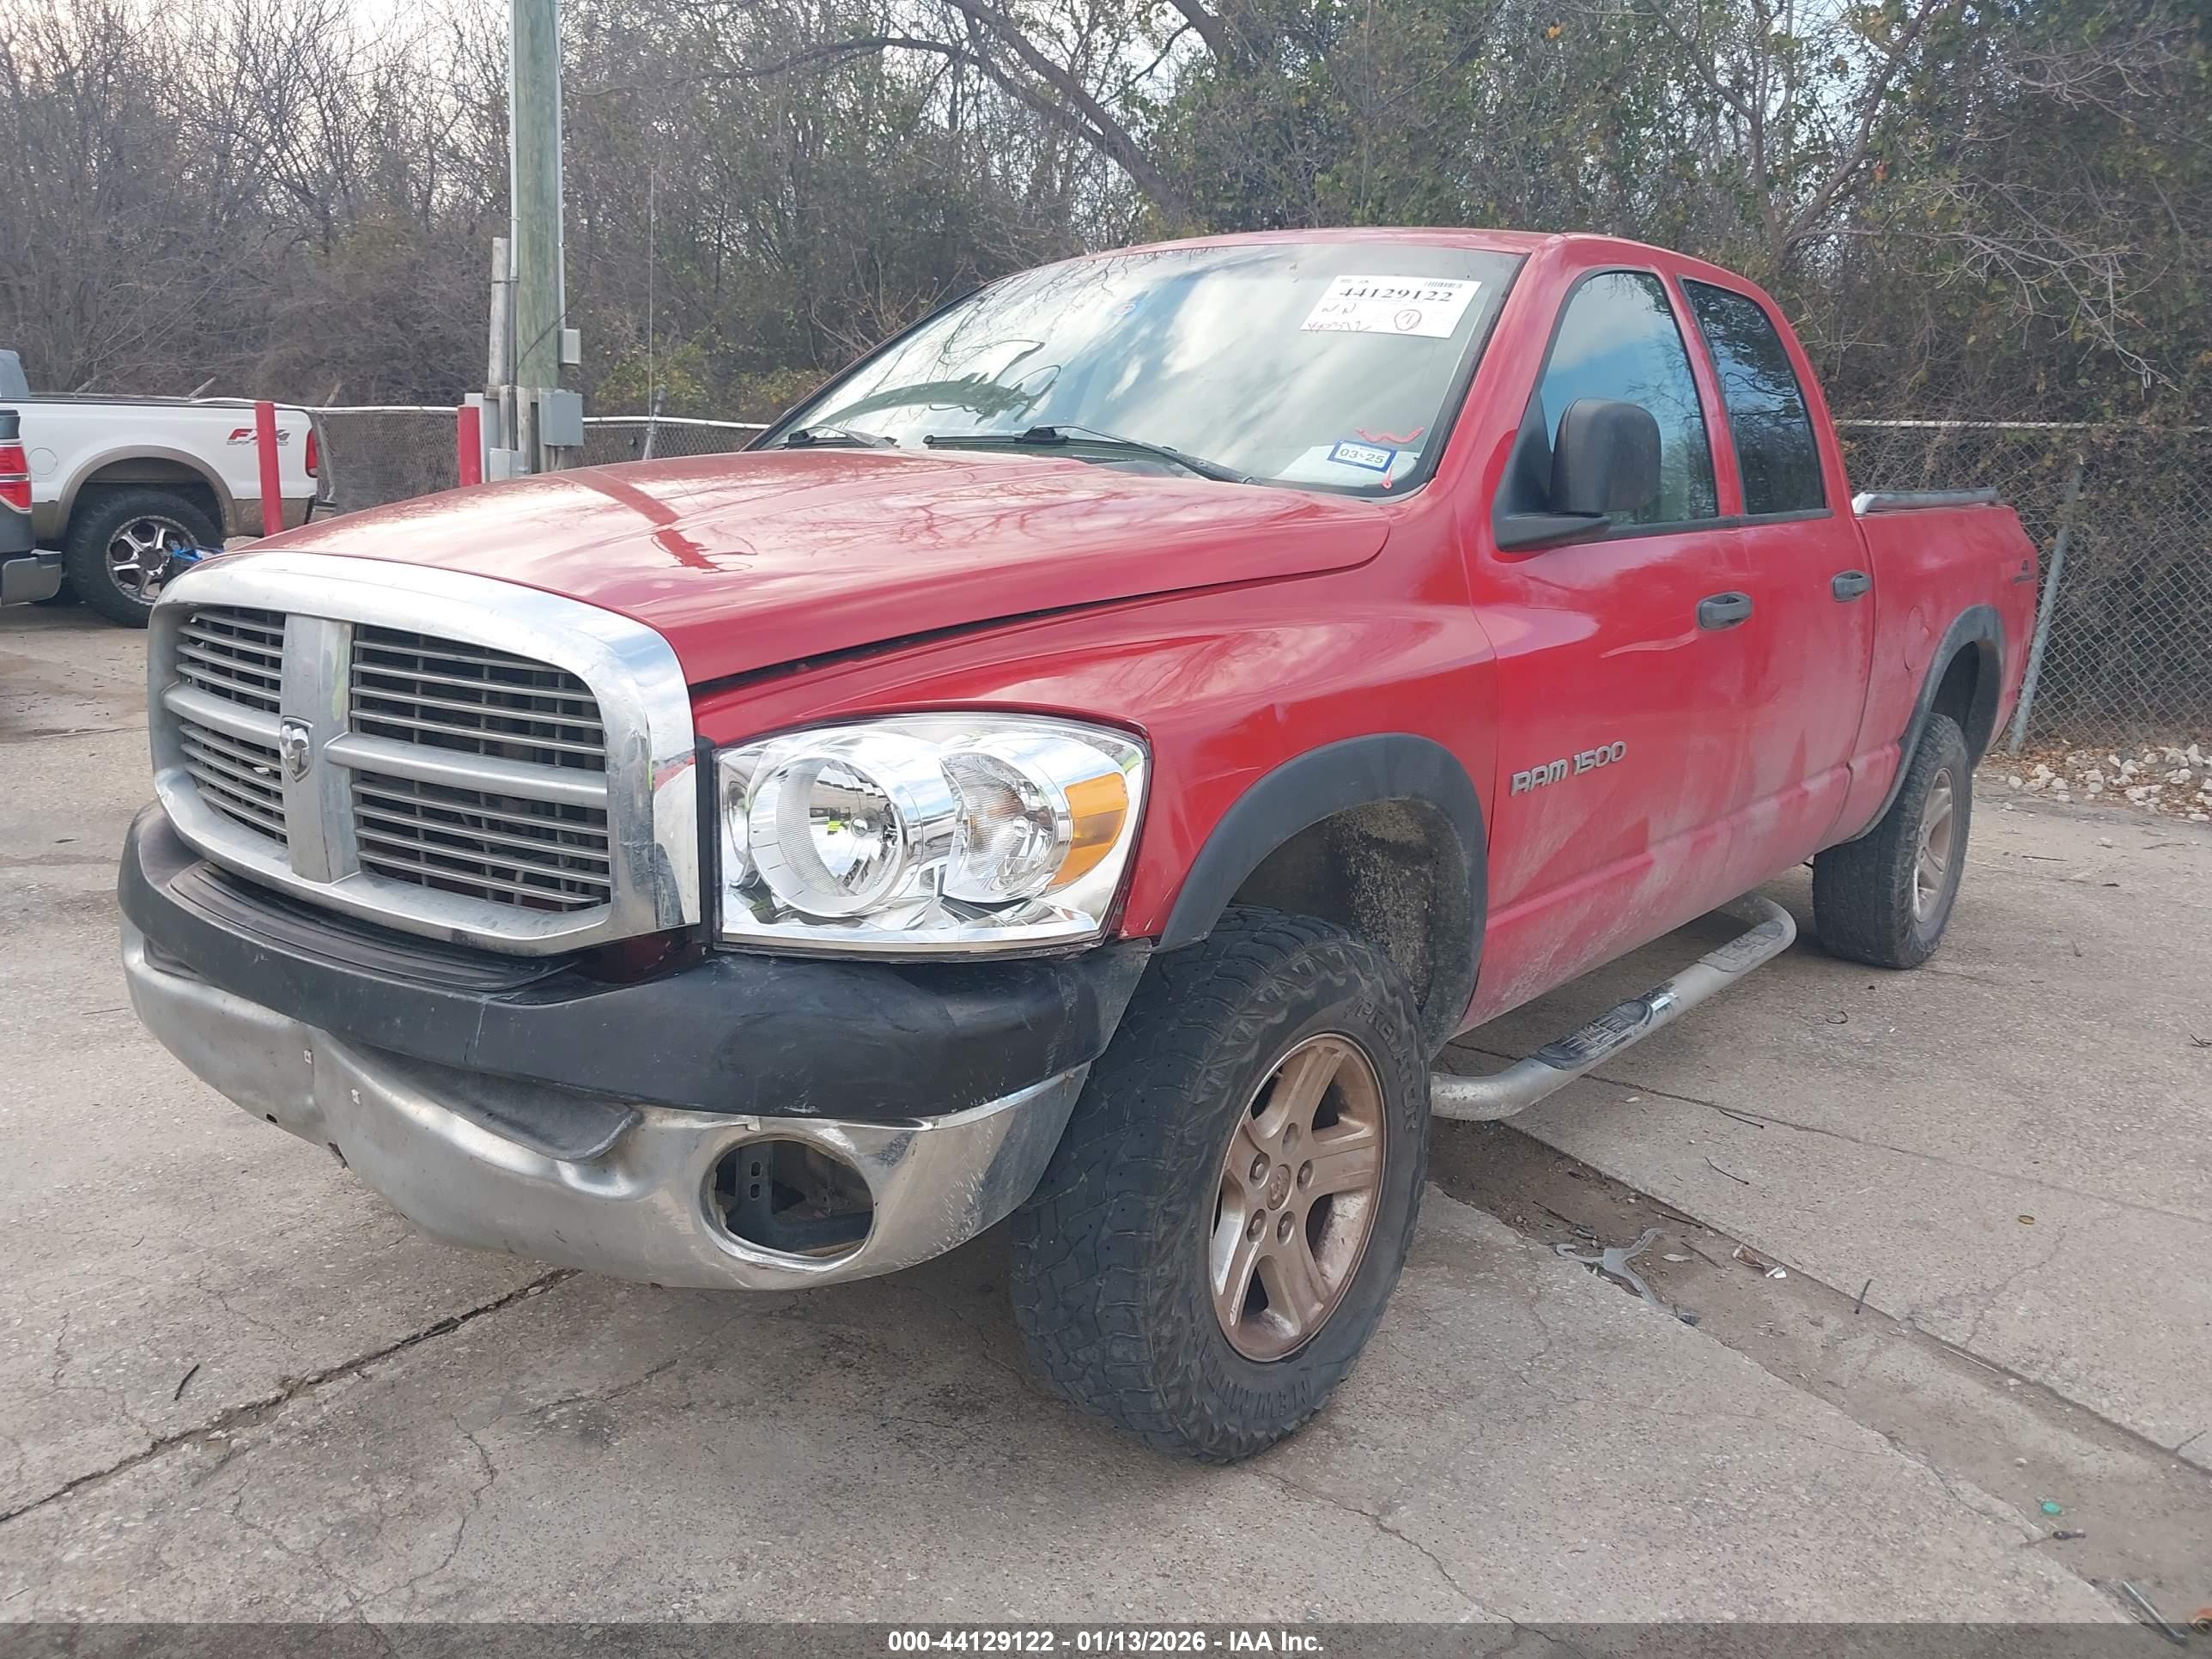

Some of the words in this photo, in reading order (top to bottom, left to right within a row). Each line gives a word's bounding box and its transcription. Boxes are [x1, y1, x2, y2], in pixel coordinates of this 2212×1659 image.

[1340, 288, 1453, 301] 44129122
[1510, 758, 1568, 797] RAM
[1572, 740, 1627, 776] 1500
